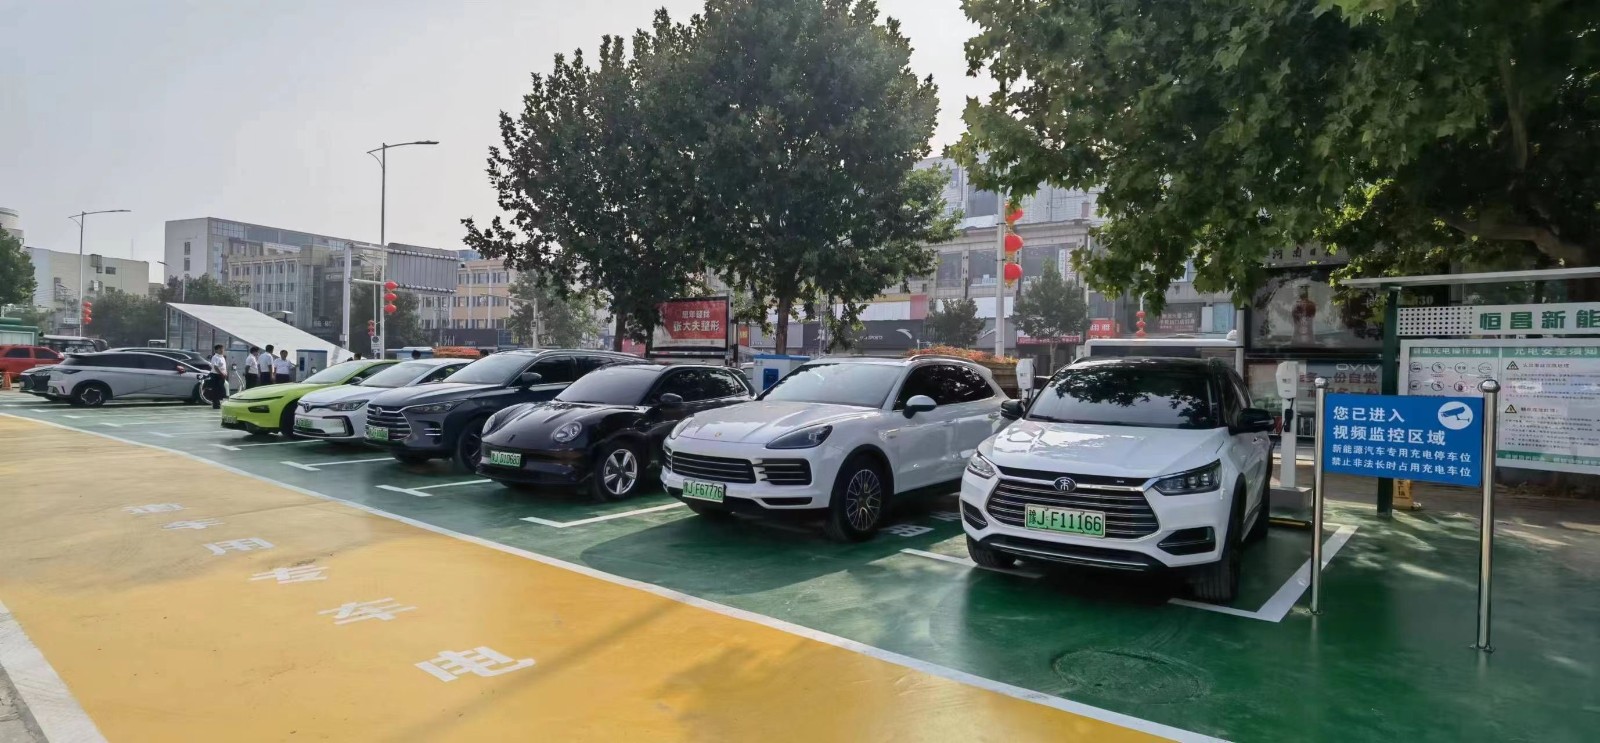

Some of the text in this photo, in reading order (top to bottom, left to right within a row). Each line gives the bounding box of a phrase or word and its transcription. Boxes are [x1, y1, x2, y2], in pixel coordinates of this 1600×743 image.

[1333, 406, 1405, 423] 您已进入
[1332, 425, 1446, 446] 视频监控区域
[1332, 443, 1472, 463] 新能源汽车专用充电停车位
[1331, 456, 1472, 477] 禁止非法长时占用充电车位
